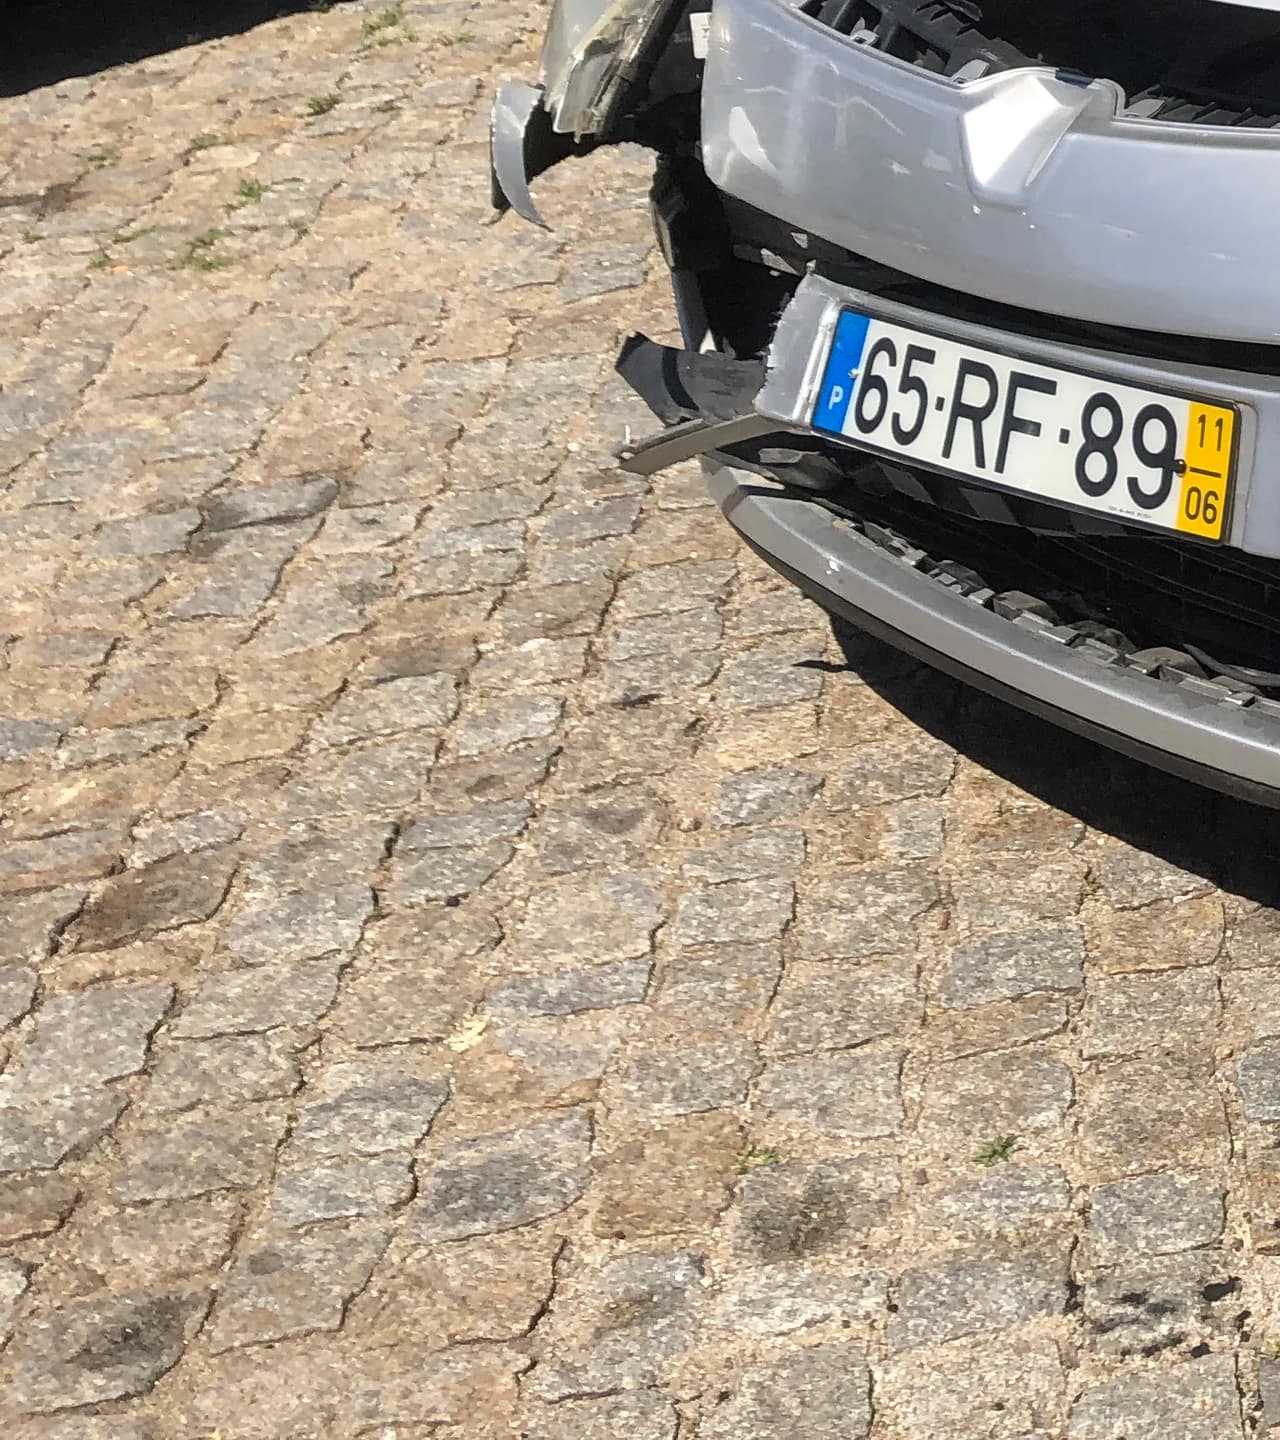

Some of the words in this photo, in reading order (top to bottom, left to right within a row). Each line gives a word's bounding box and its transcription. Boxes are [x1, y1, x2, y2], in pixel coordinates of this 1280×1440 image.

[828, 385, 844, 410] P
[1198, 414, 1224, 453] 11
[1185, 486, 1220, 525] 06
